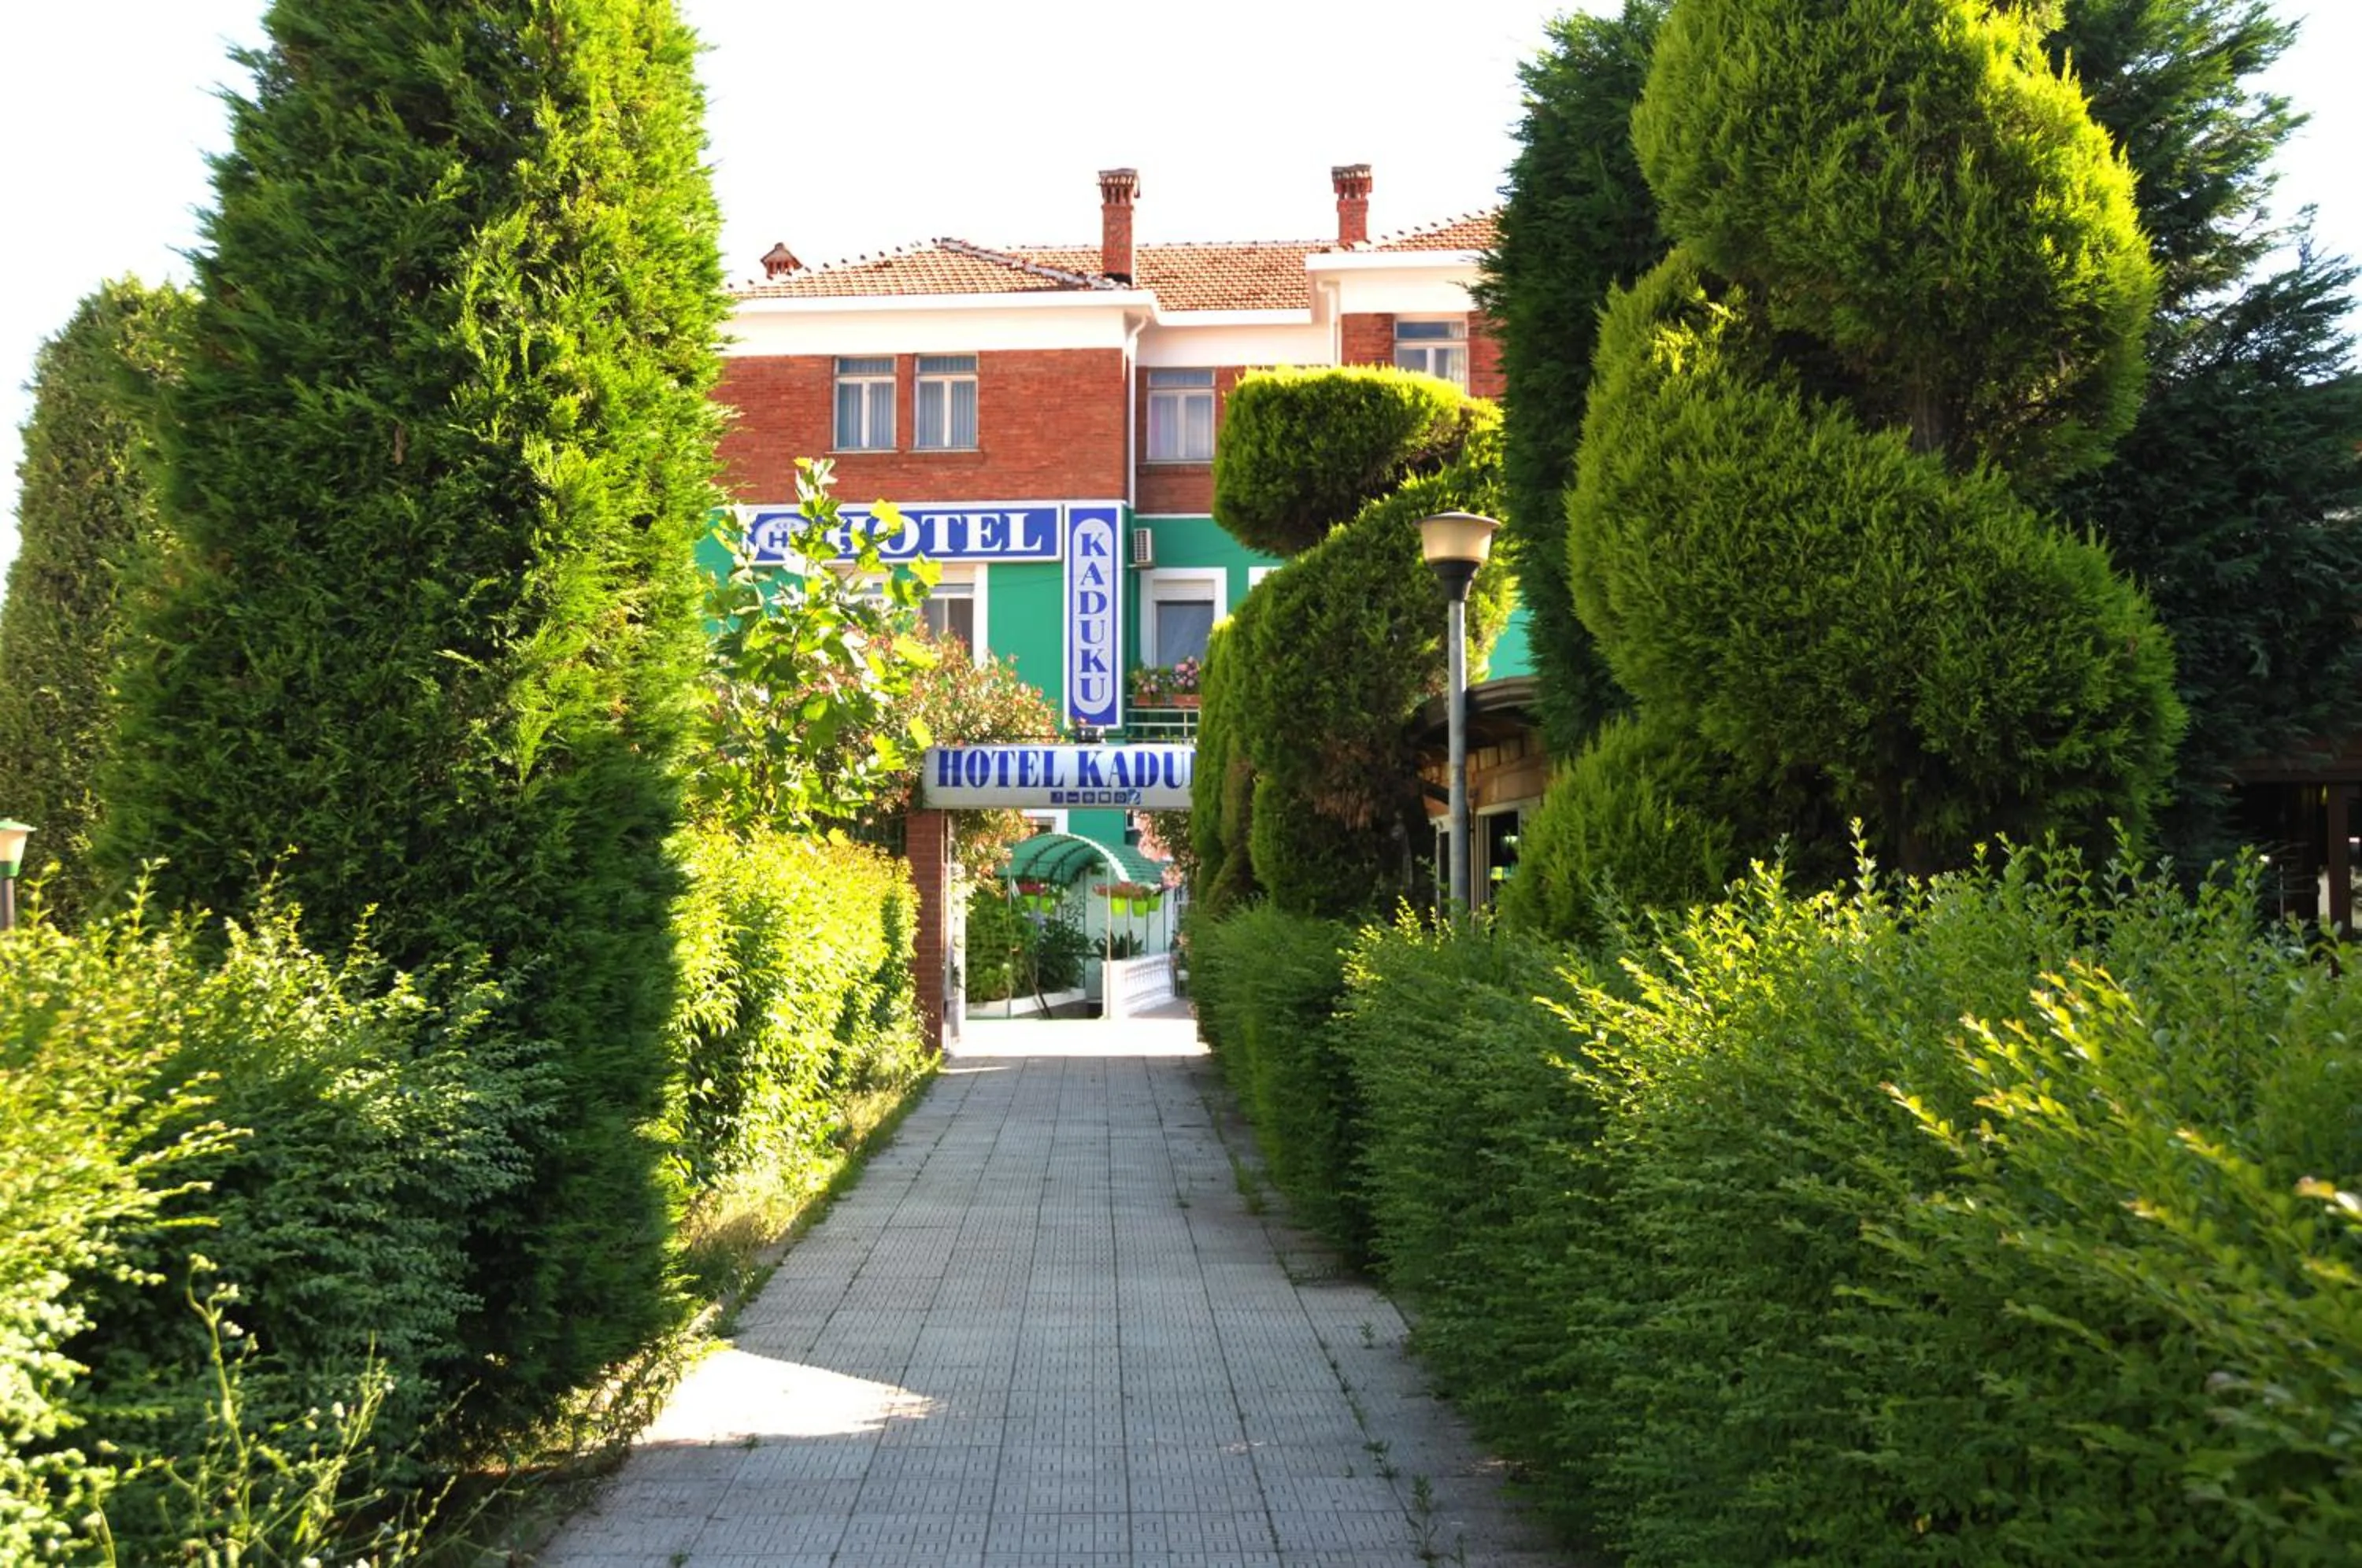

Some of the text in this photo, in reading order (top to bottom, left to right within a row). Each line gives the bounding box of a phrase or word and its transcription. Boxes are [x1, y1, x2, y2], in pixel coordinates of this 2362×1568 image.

[824, 512, 1042, 554] HOTEL
[1079, 532, 1108, 703] KADUKU
[935, 749, 1196, 789] HOTEL KADU
